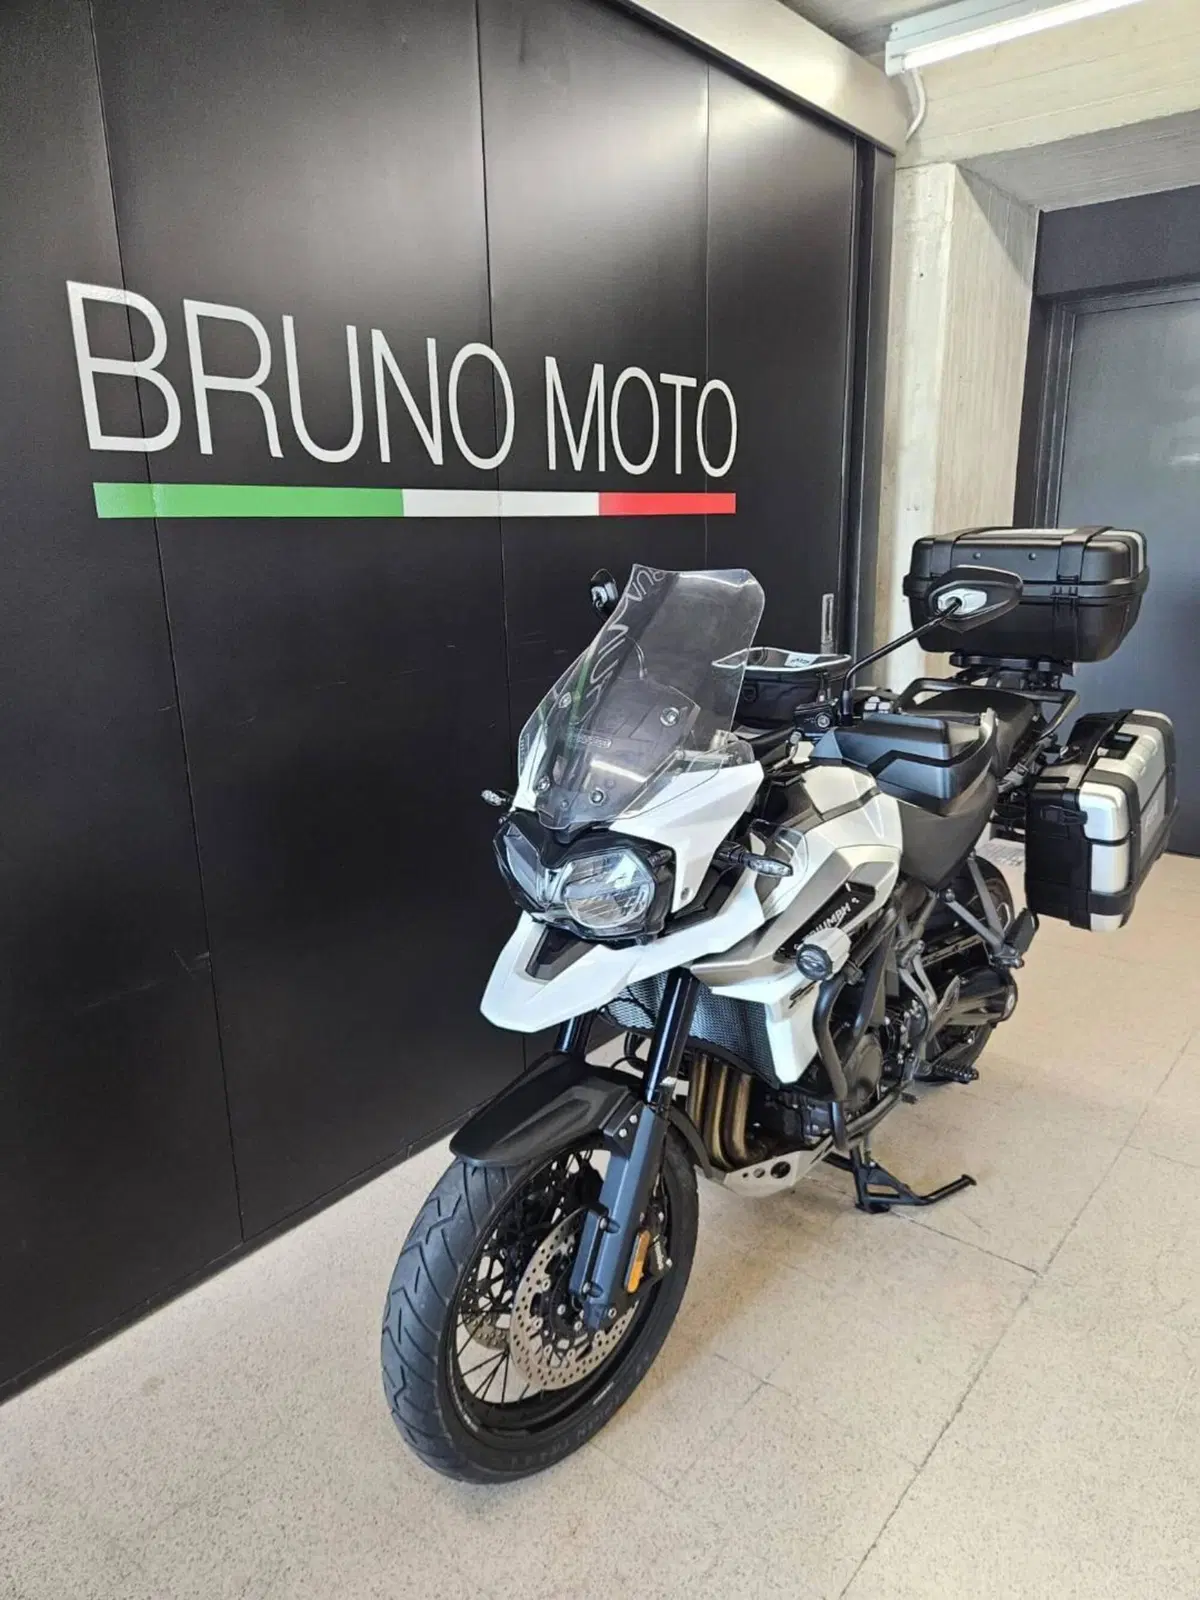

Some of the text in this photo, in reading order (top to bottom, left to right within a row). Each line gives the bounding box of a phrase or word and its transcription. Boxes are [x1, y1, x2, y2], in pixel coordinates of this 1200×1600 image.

[66, 280, 738, 479] BRUNO MOTO
[804, 902, 851, 939] IUMPH
